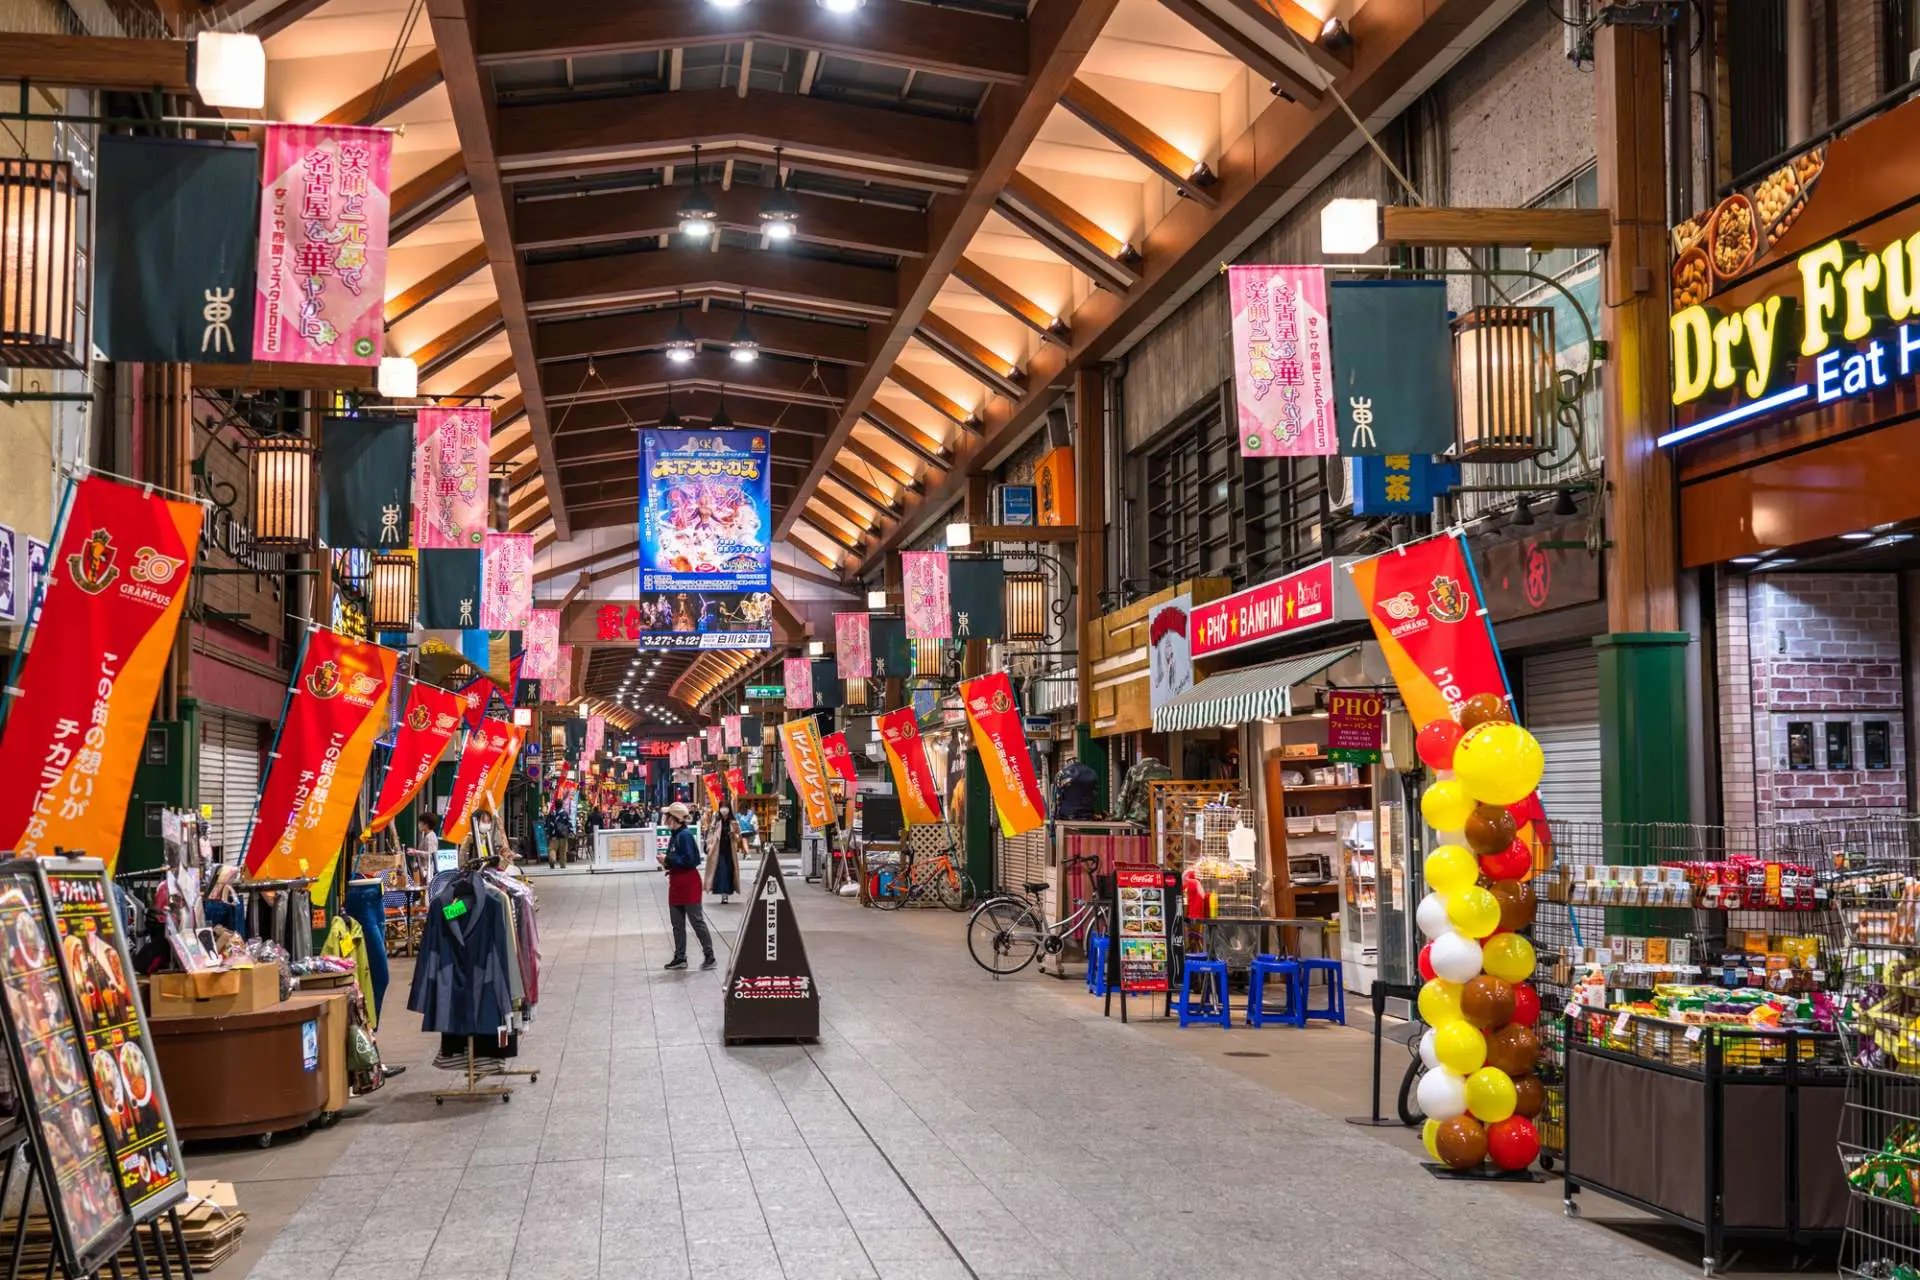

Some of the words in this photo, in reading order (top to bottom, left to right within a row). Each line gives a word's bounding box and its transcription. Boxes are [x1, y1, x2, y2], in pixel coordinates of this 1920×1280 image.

[296, 151, 332, 336] 名古屋を華やかに
[1670, 295, 1781, 405] Dry
[1816, 340, 1887, 403] Eat
[651, 458, 759, 479] 木下大サーカス
[120, 583, 171, 606] GRAMPUS
[718, 635, 757, 643] 白川公園
[1207, 604, 1228, 646] PHỞ
[59, 651, 118, 820] この街の想いが
[304, 732, 345, 830] この街の想いが
[280, 770, 315, 856] チカラになる
[767, 901, 775, 929] THIS
[767, 934, 775, 959] WAY
[735, 991, 810, 999] OSUKANNON
